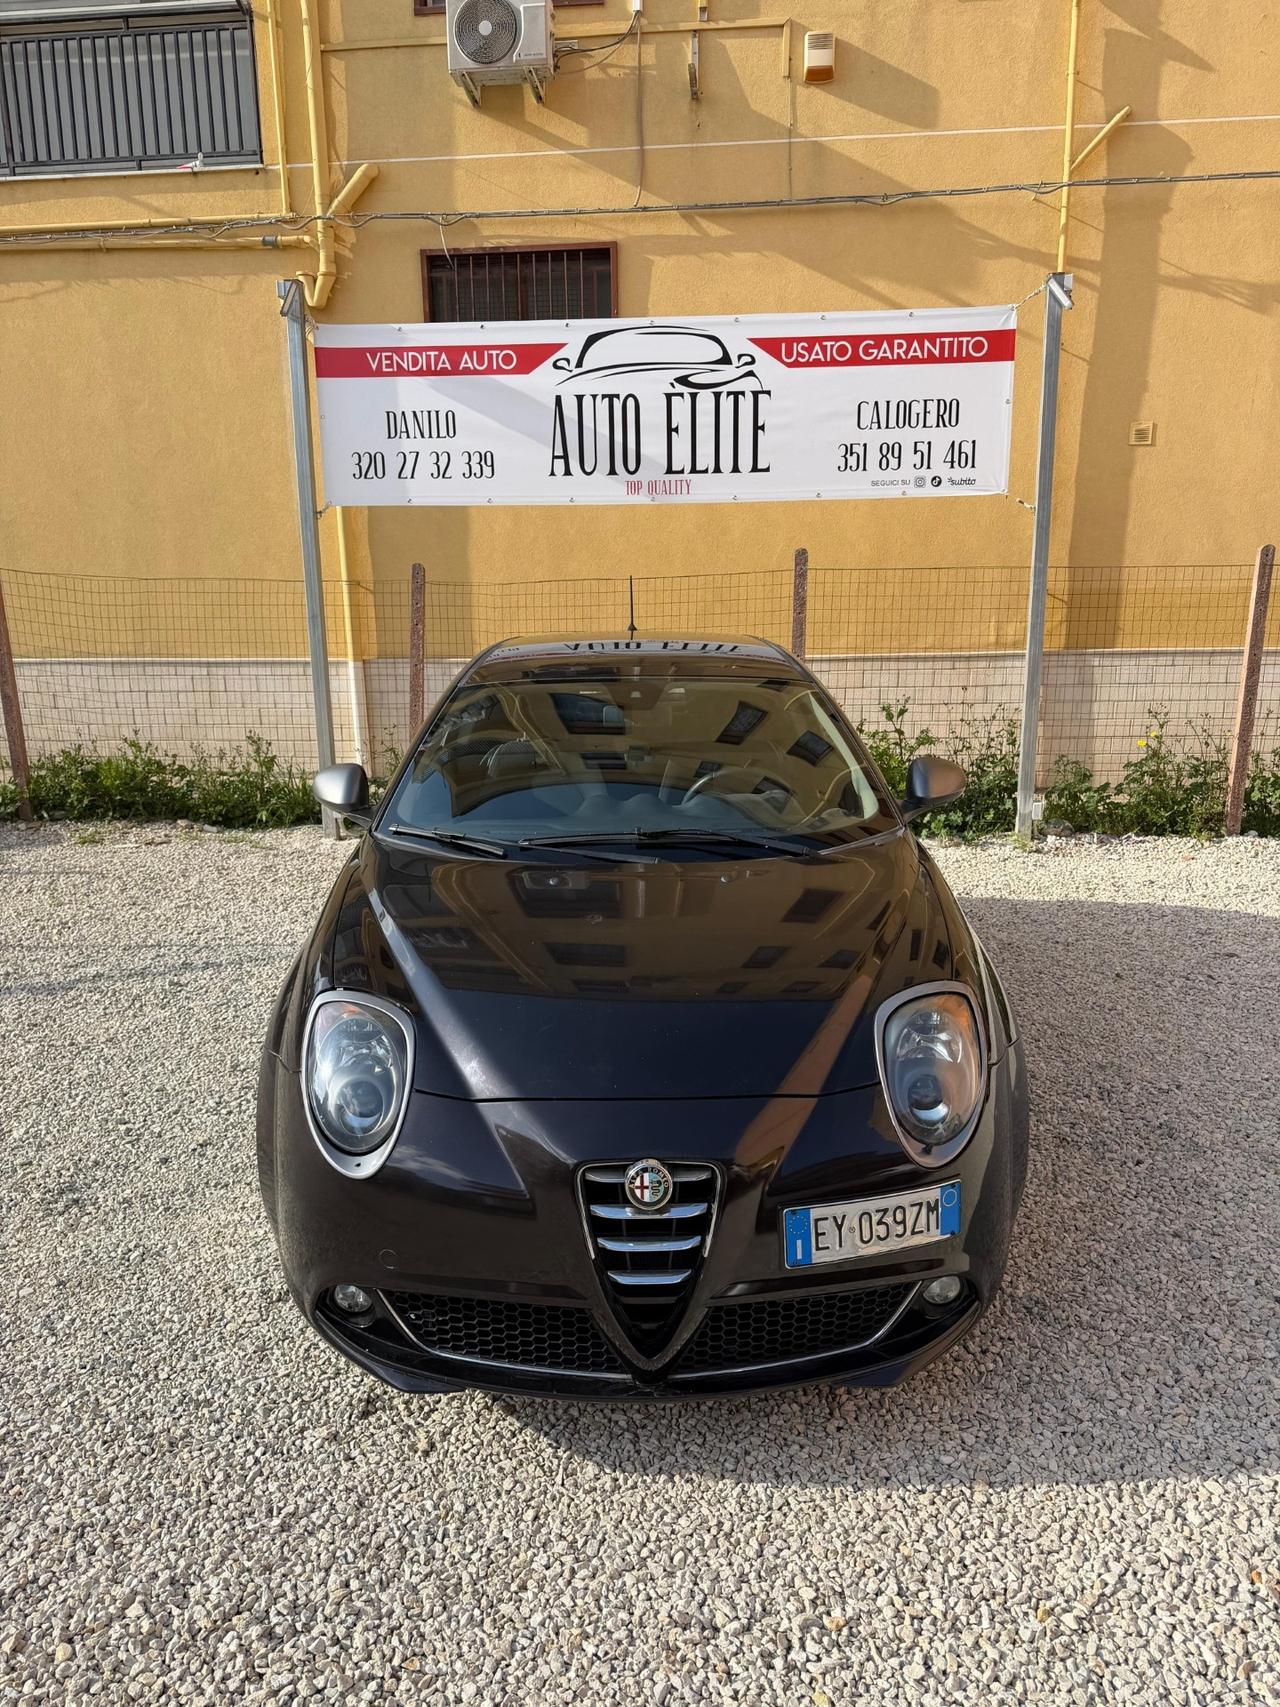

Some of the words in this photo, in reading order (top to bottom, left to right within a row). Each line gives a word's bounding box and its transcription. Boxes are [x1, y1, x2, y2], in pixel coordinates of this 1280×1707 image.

[366, 350, 452, 373] VENDITA
[459, 349, 517, 371] AUTO
[781, 340, 852, 363] USATO
[858, 336, 989, 361] GARANTITO
[385, 410, 457, 439] DANILO
[856, 398, 960, 431] CALOGERO
[548, 393, 641, 477] AUTO
[663, 382, 772, 476] ÈLITE
[351, 451, 386, 480] 320
[396, 451, 420, 480] 27
[429, 450, 453, 480] 32
[461, 450, 496, 480] 339
[837, 442, 868, 472] 351
[878, 441, 902, 471] 89
[913, 440, 932, 470] 51
[943, 439, 977, 469] 461
[625, 480, 643, 496] TOP
[647, 479, 692, 496] QUALITY
[870, 479, 899, 487] SEGUICI
[949, 477, 976, 486] subito
